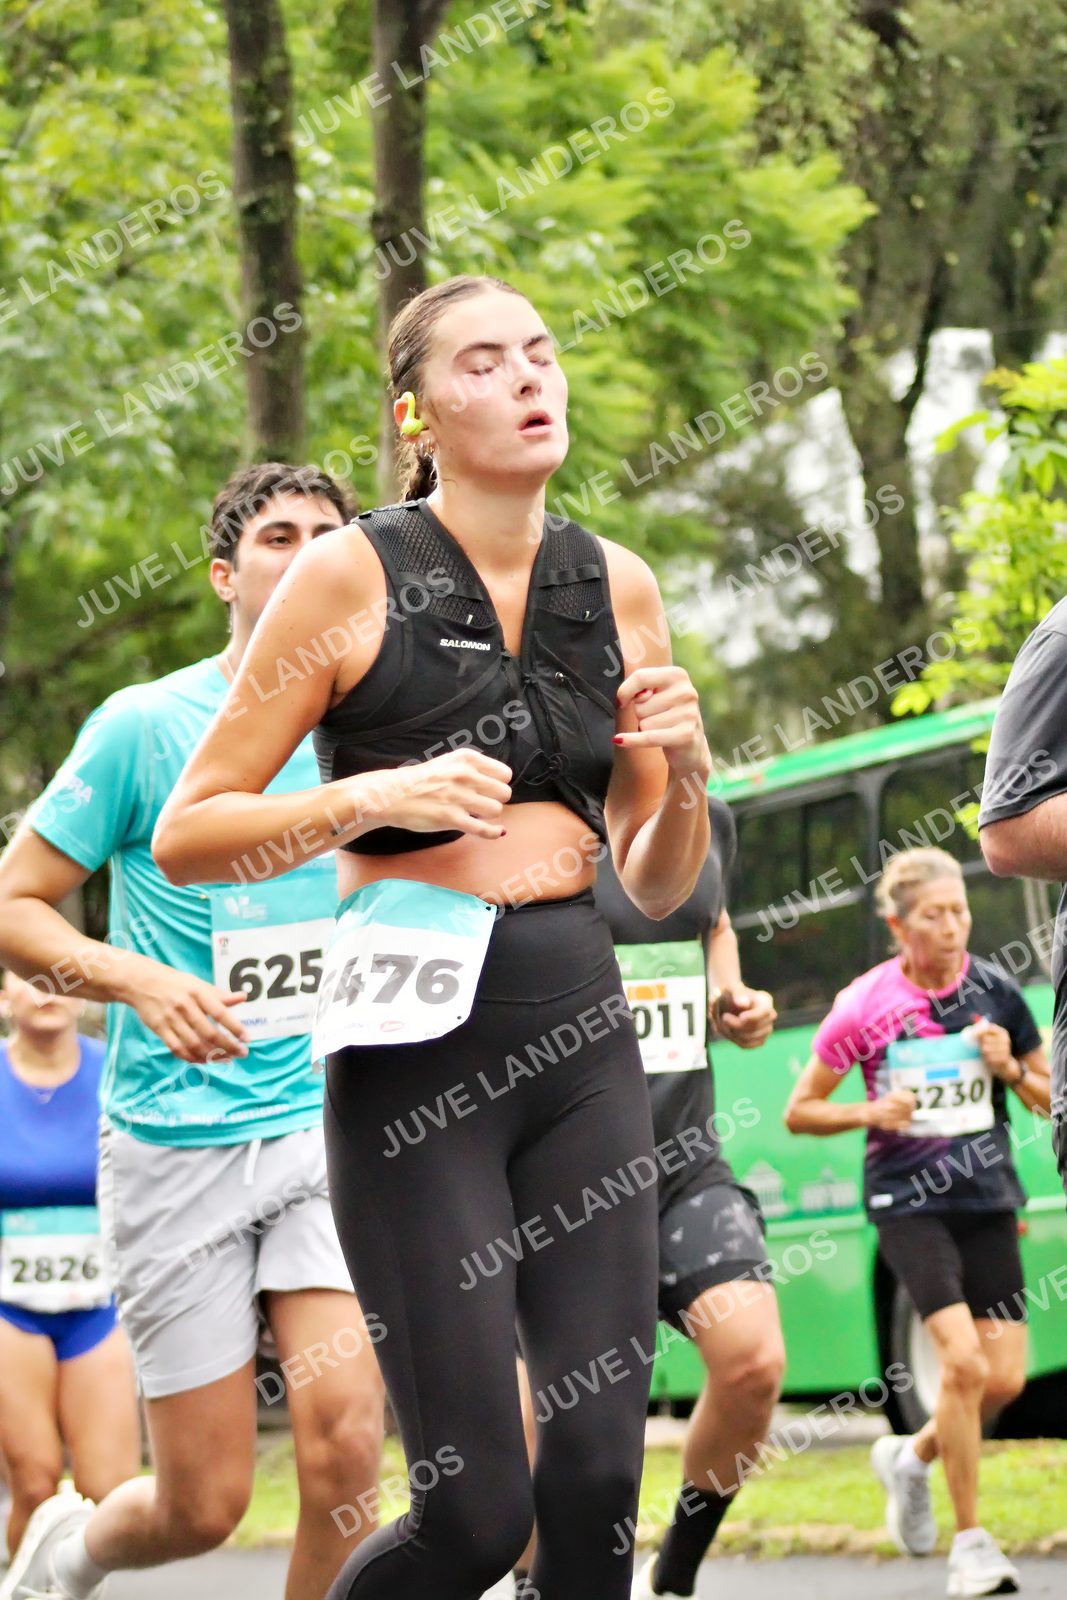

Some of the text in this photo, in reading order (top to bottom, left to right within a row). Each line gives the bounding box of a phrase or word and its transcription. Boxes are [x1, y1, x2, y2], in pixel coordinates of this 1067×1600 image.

[440, 638, 490, 651] SALOMON
[229, 948, 323, 1003] 625
[10, 1252, 99, 1284] 2826
